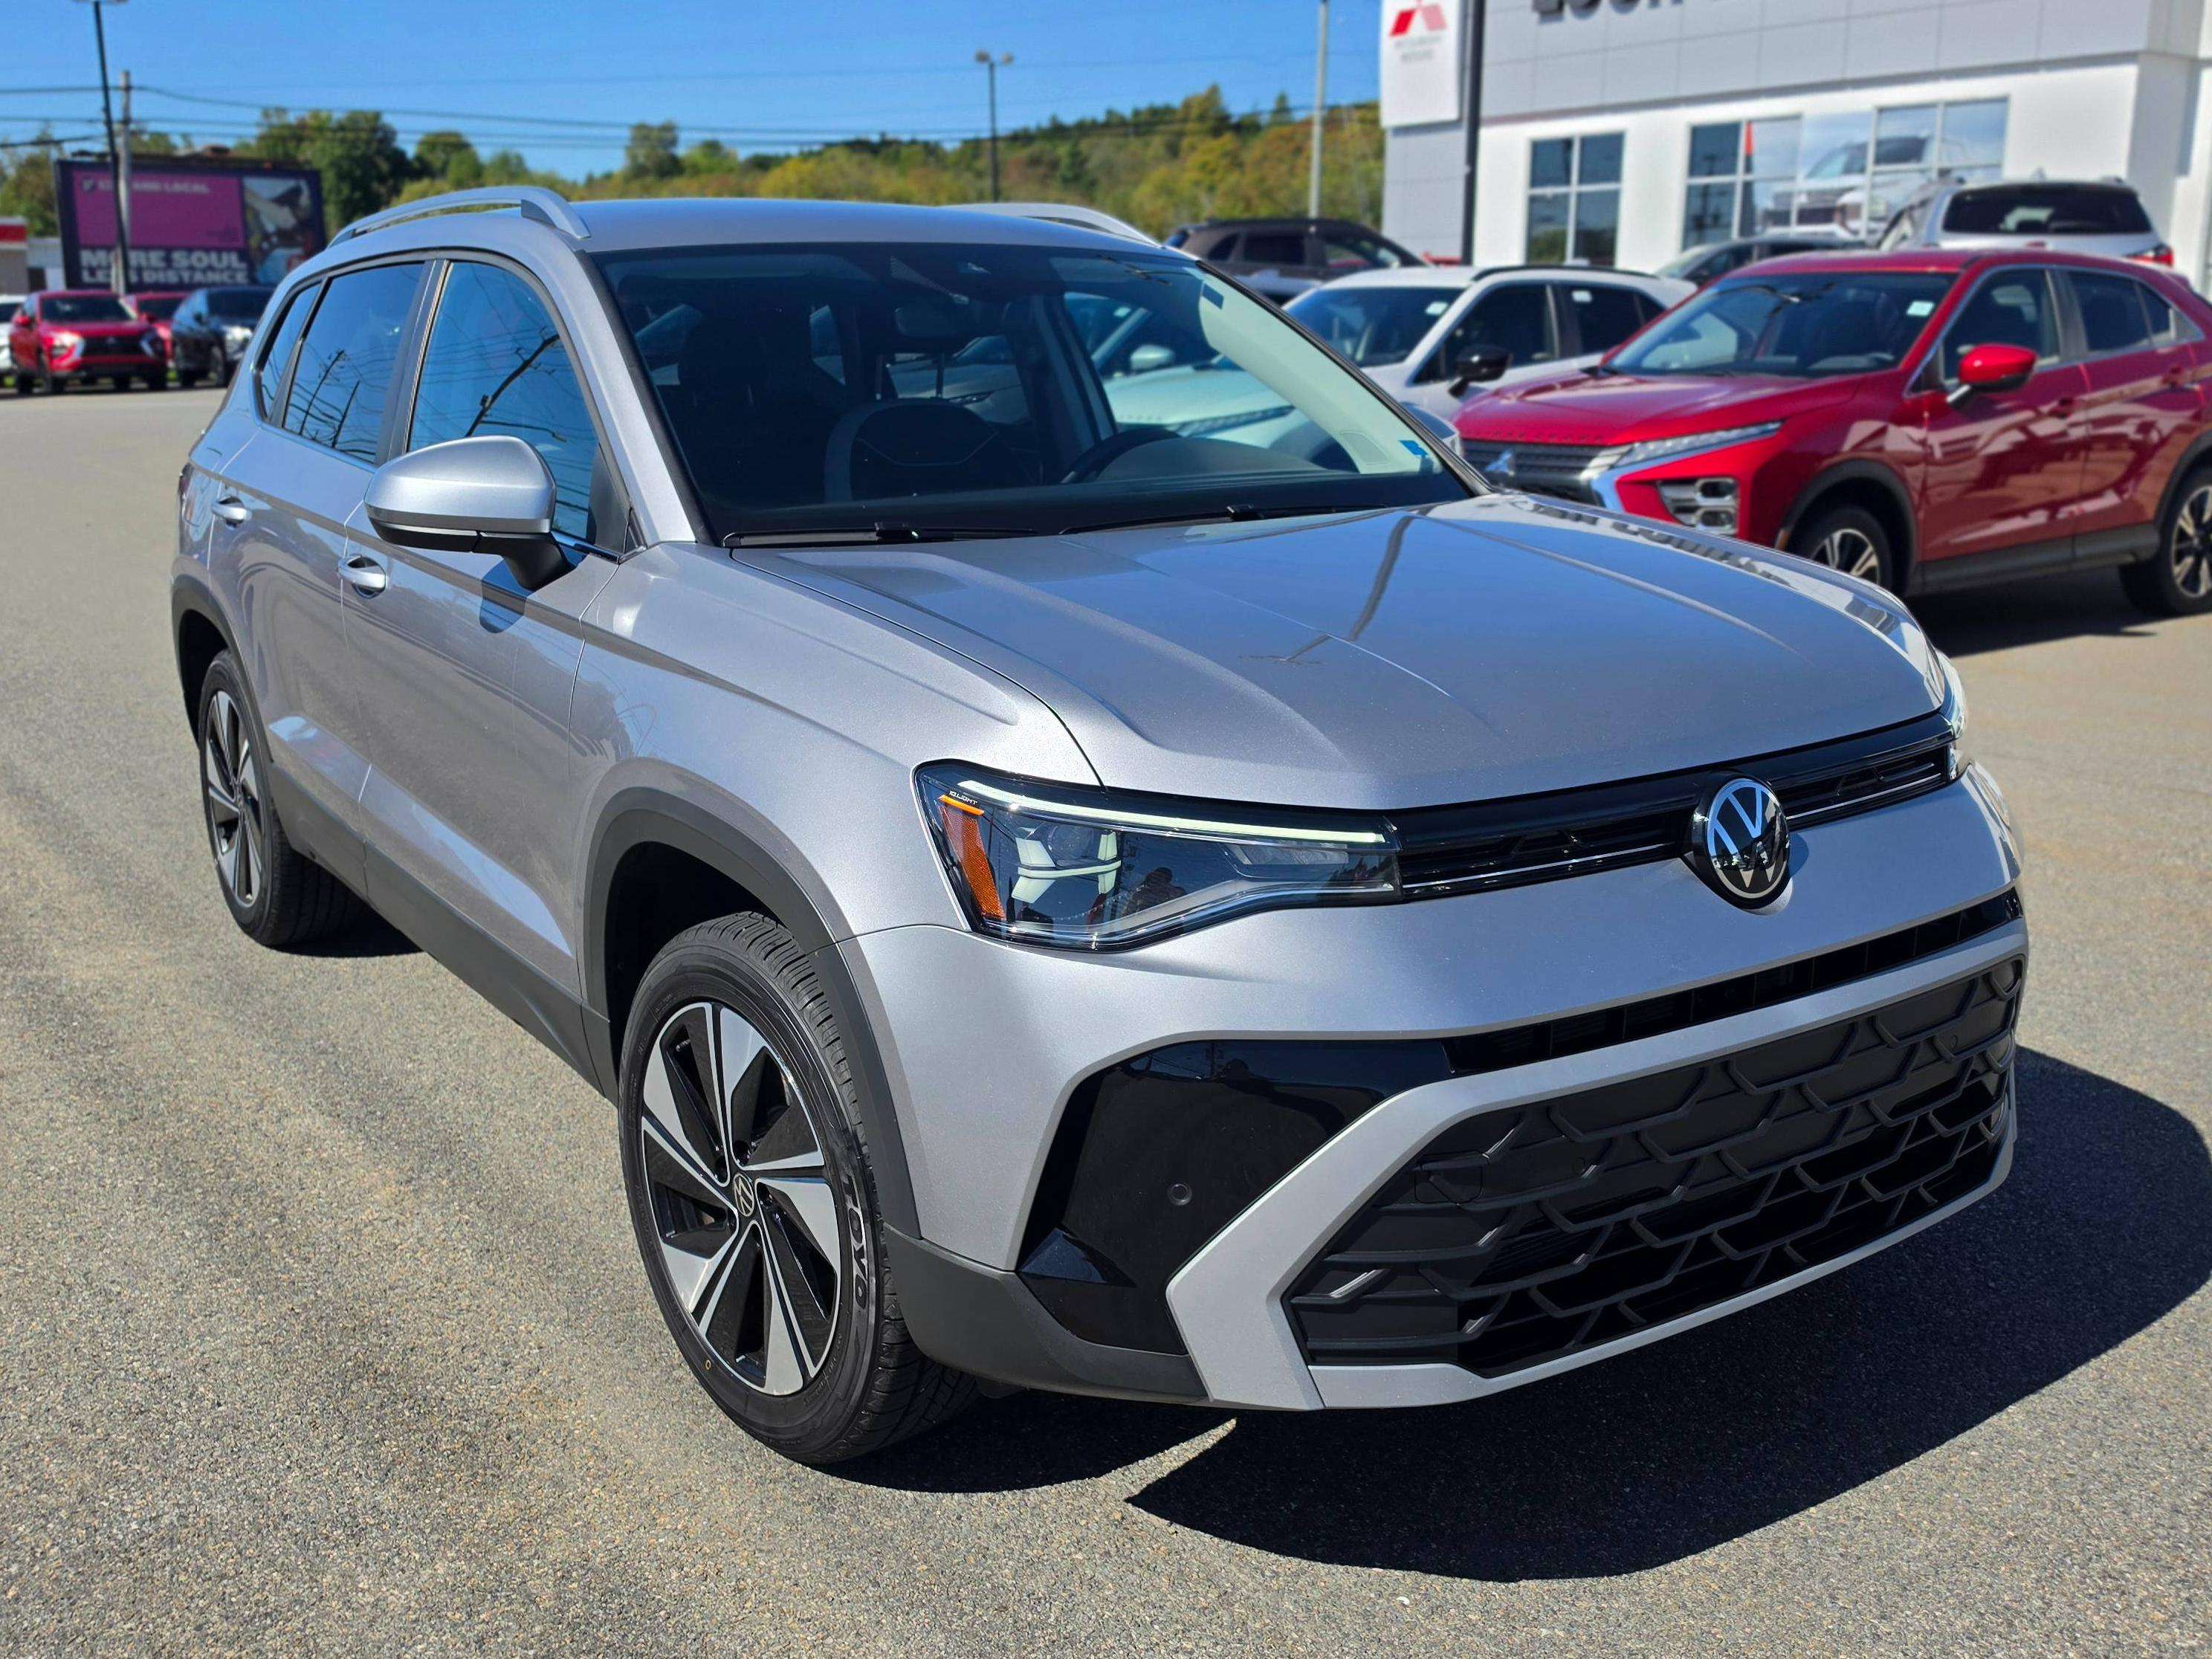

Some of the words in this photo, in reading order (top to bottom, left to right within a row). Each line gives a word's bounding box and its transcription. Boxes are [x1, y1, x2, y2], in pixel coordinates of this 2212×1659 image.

[80, 249, 166, 268] MRE
[171, 250, 248, 269] SOUL
[81, 268, 139, 284] LES
[141, 269, 249, 285] DISTANCE
[841, 1172, 868, 1310] TOYO
